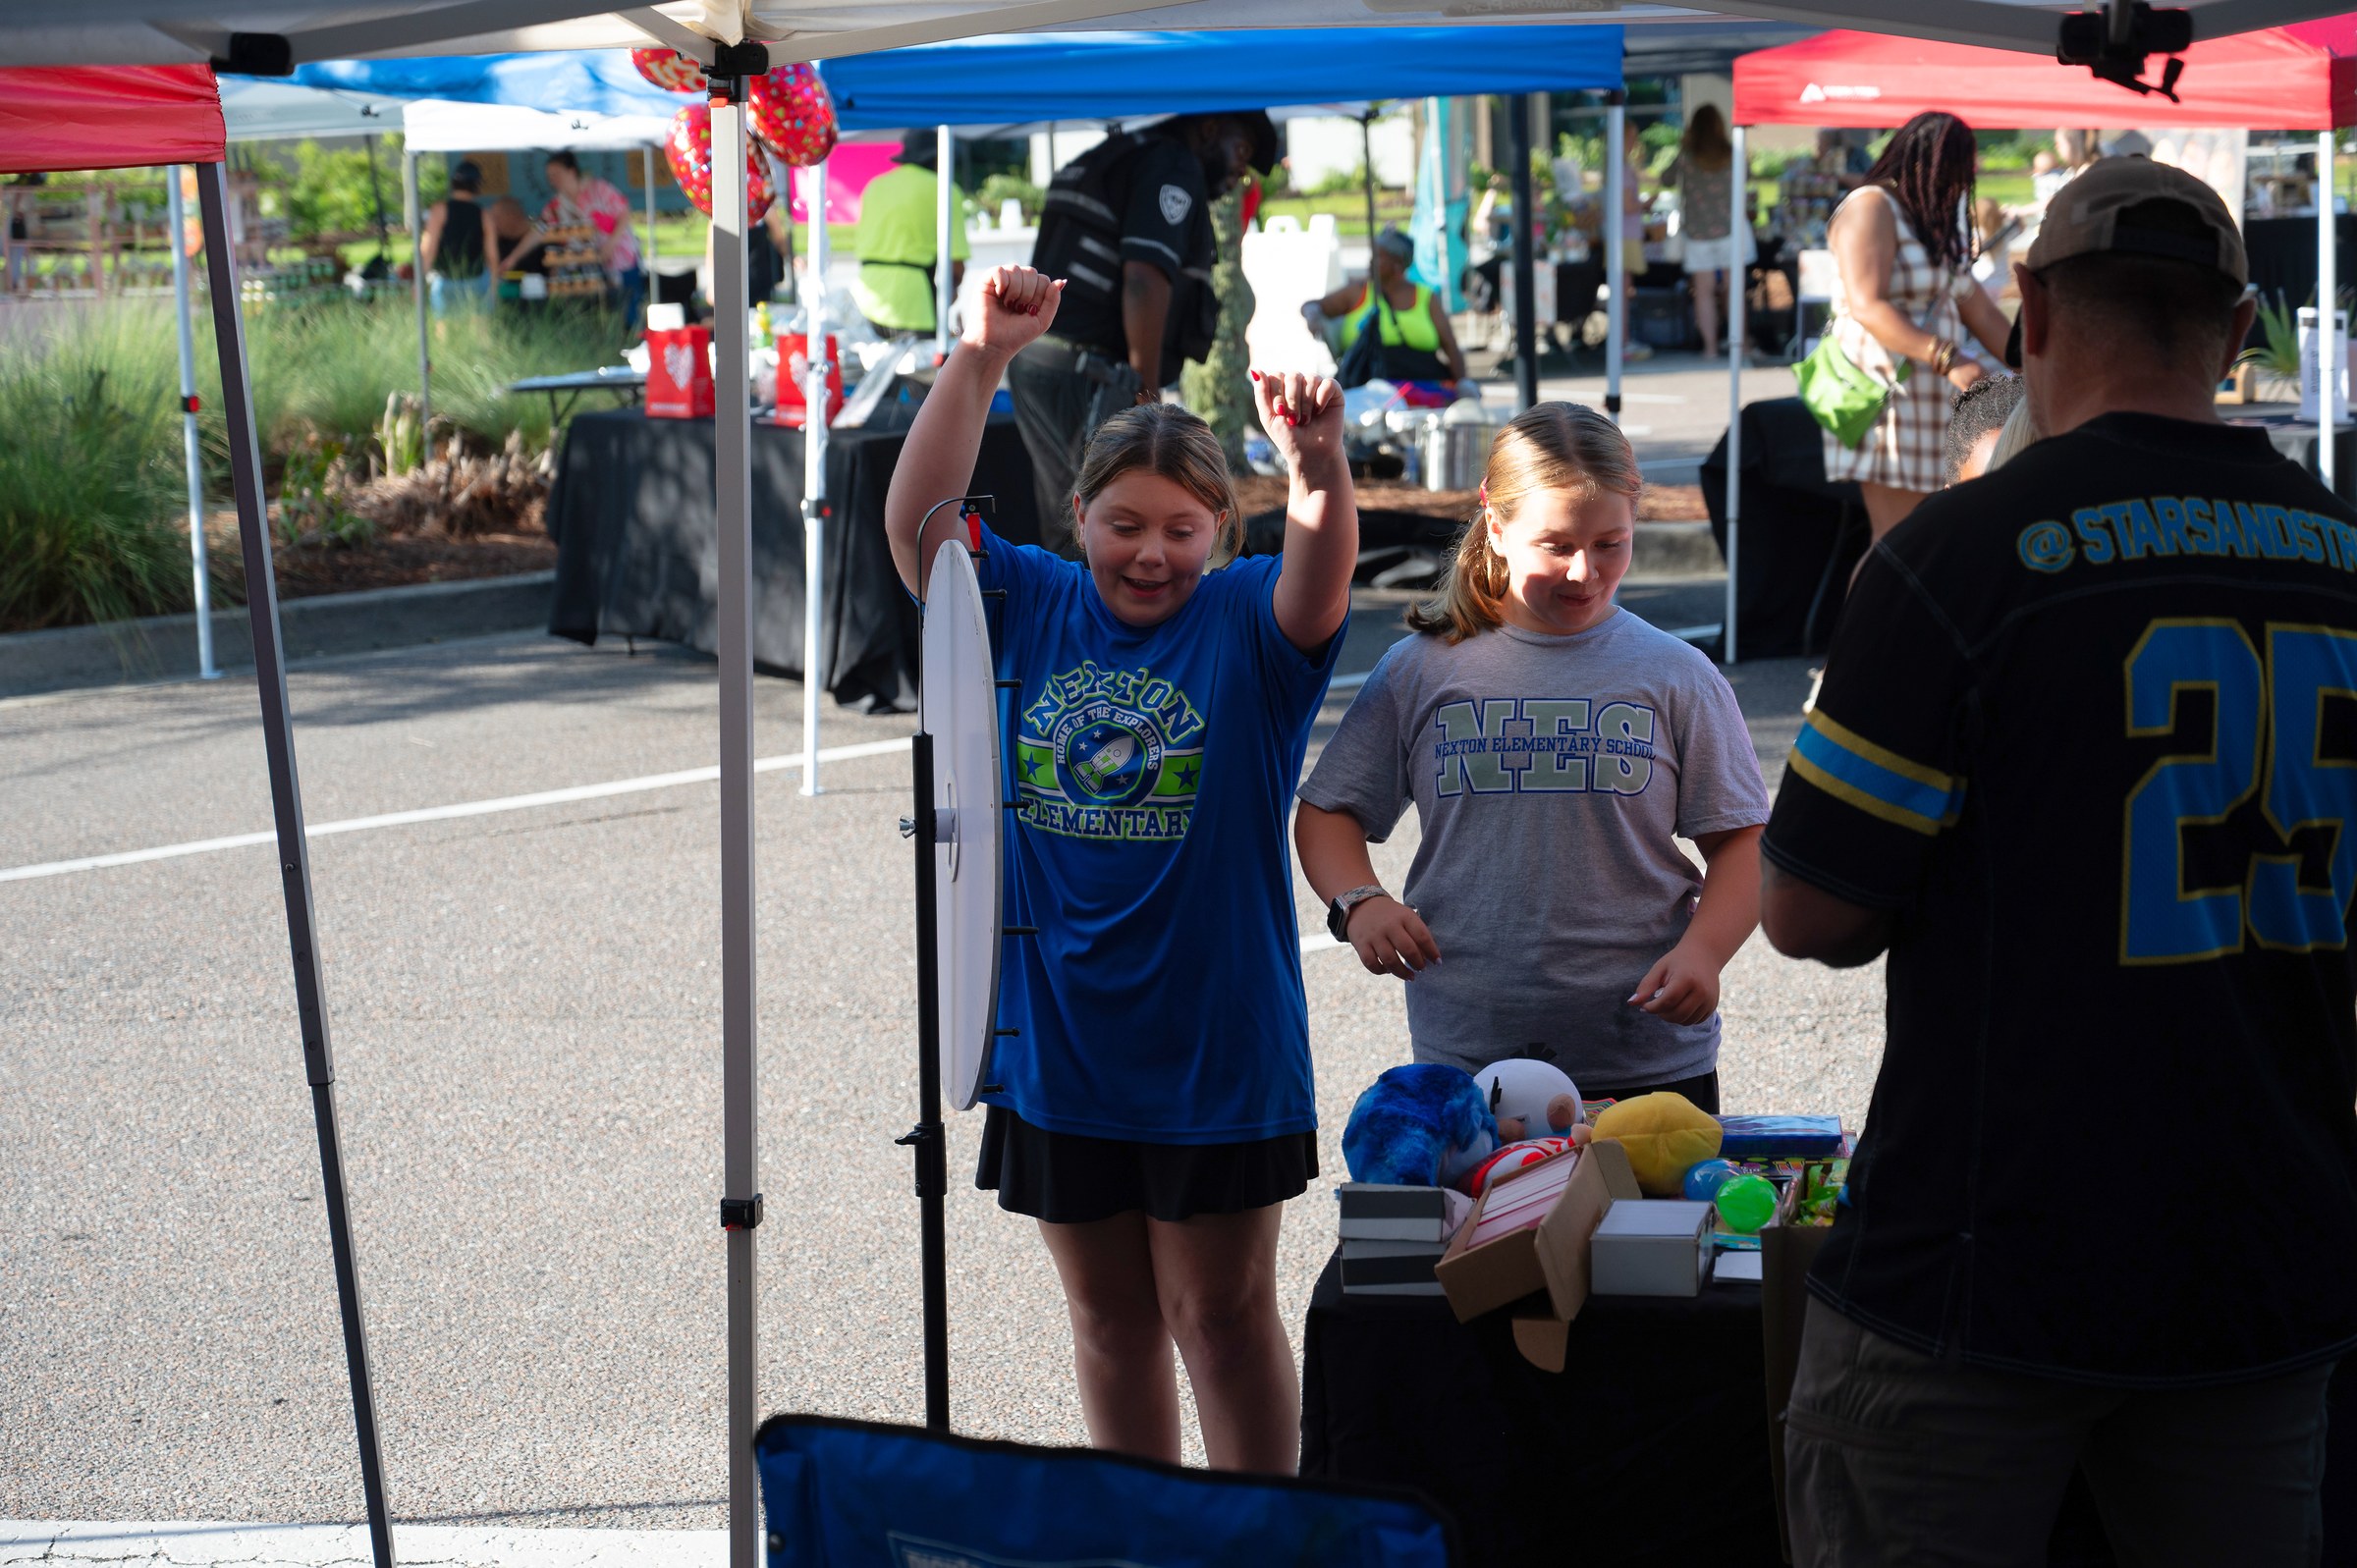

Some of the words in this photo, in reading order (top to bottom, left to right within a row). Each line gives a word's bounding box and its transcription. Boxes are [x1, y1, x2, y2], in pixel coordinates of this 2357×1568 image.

[2017, 497, 2357, 573] @STARSANDSTR
[1023, 660, 1205, 744] NEXTON
[1057, 725, 1072, 764] HOME
[1072, 715, 1085, 729] OF
[1088, 706, 1110, 720] THE
[1113, 711, 1160, 771] EXPLORERS
[1435, 737, 1487, 759] NEXTON
[1492, 737, 1602, 753] ELEMENTARY
[1606, 738, 1657, 761] SCHOOL
[1436, 698, 1655, 798] NES
[2119, 618, 2357, 966] 25
